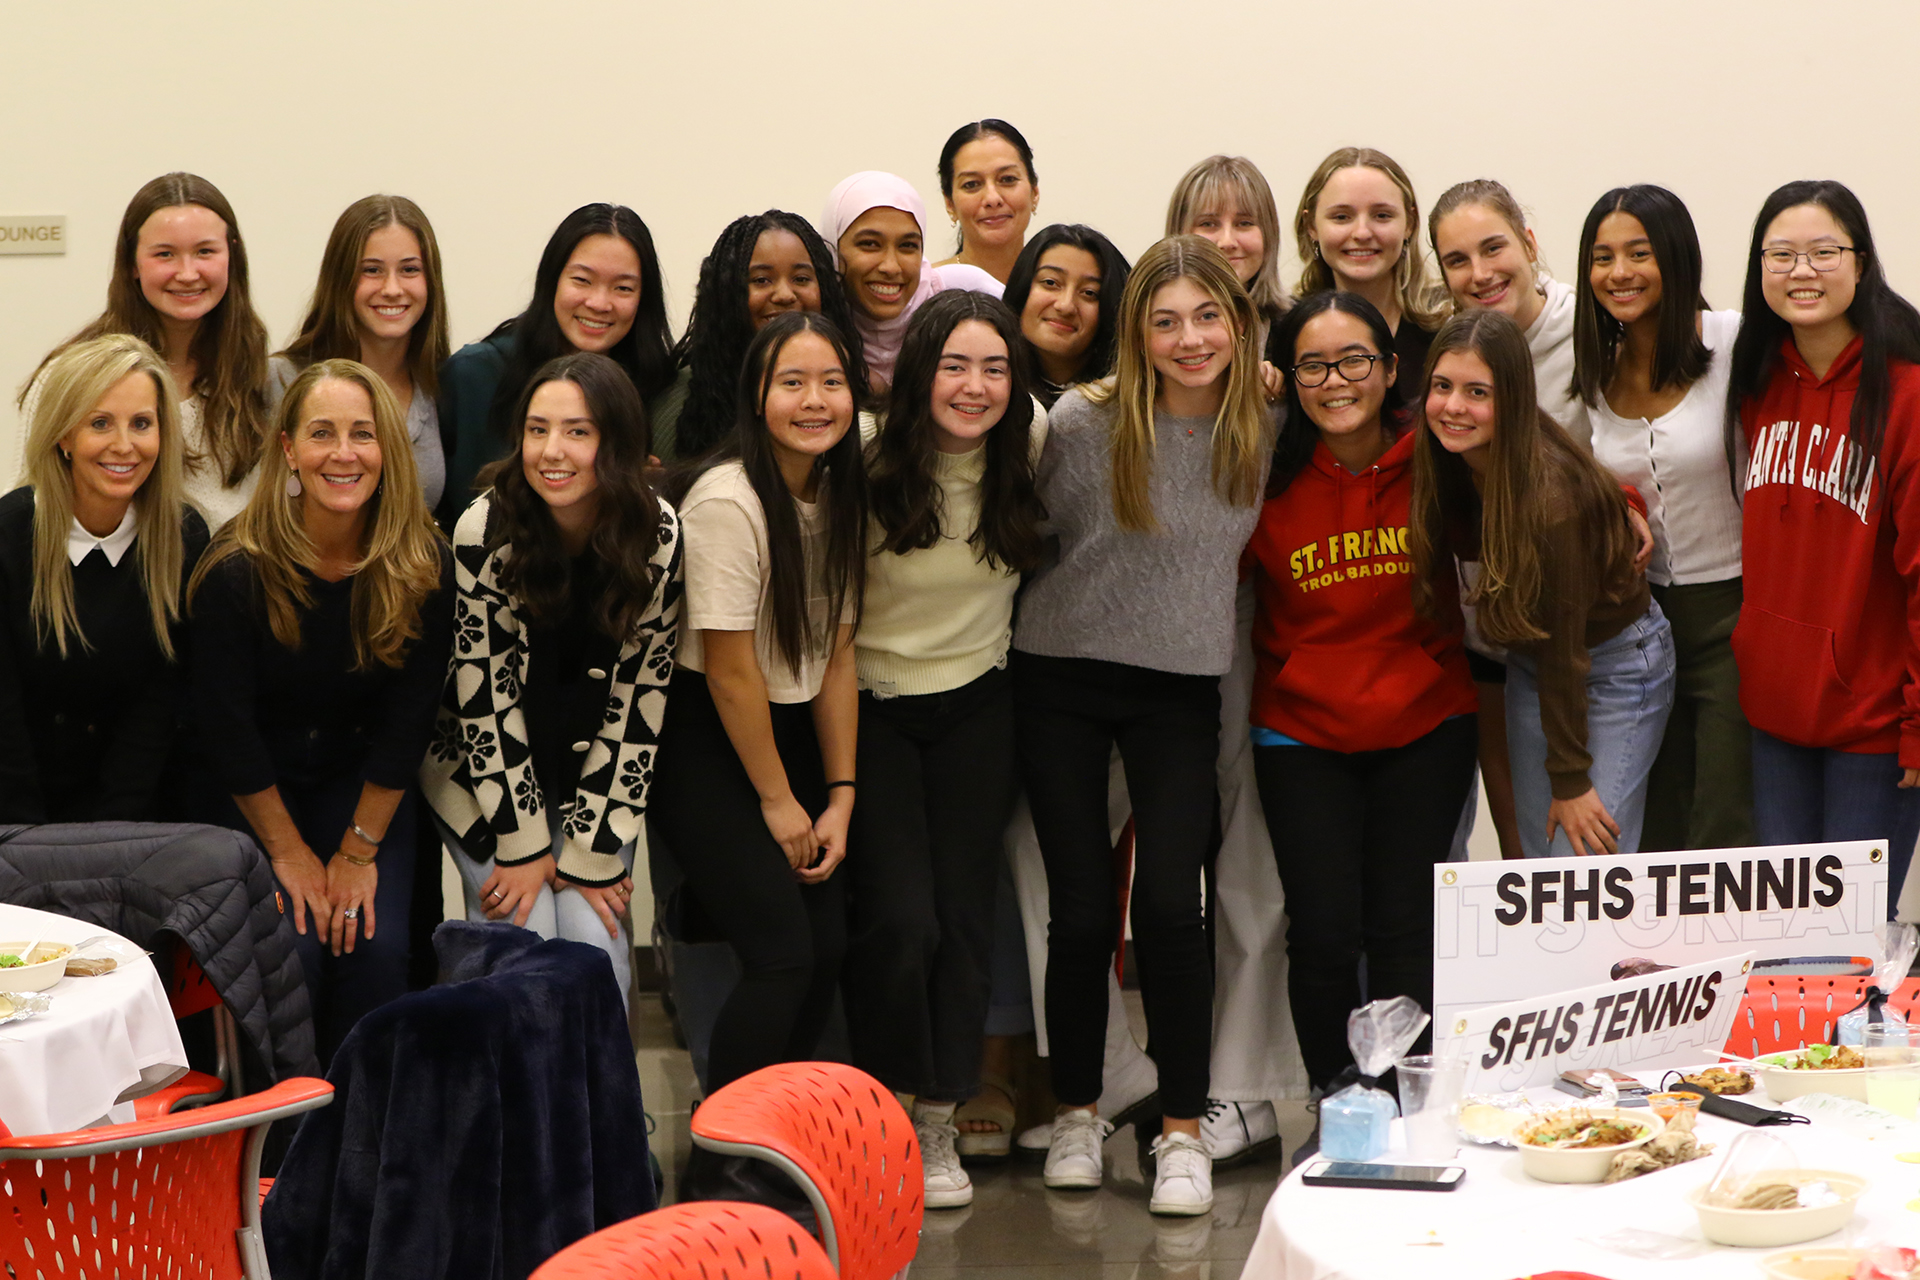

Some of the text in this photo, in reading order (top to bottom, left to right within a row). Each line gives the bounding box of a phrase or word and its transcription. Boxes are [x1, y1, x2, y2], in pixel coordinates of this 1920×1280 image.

[1744, 420, 1800, 492] ANTA
[1290, 541, 1325, 580] ST.
[1299, 562, 1416, 593] TROUBADOU
[1495, 855, 1843, 926] SFHS TENNIS
[1481, 1001, 1584, 1070] SFHS
[1587, 970, 1722, 1047] TENNIS
